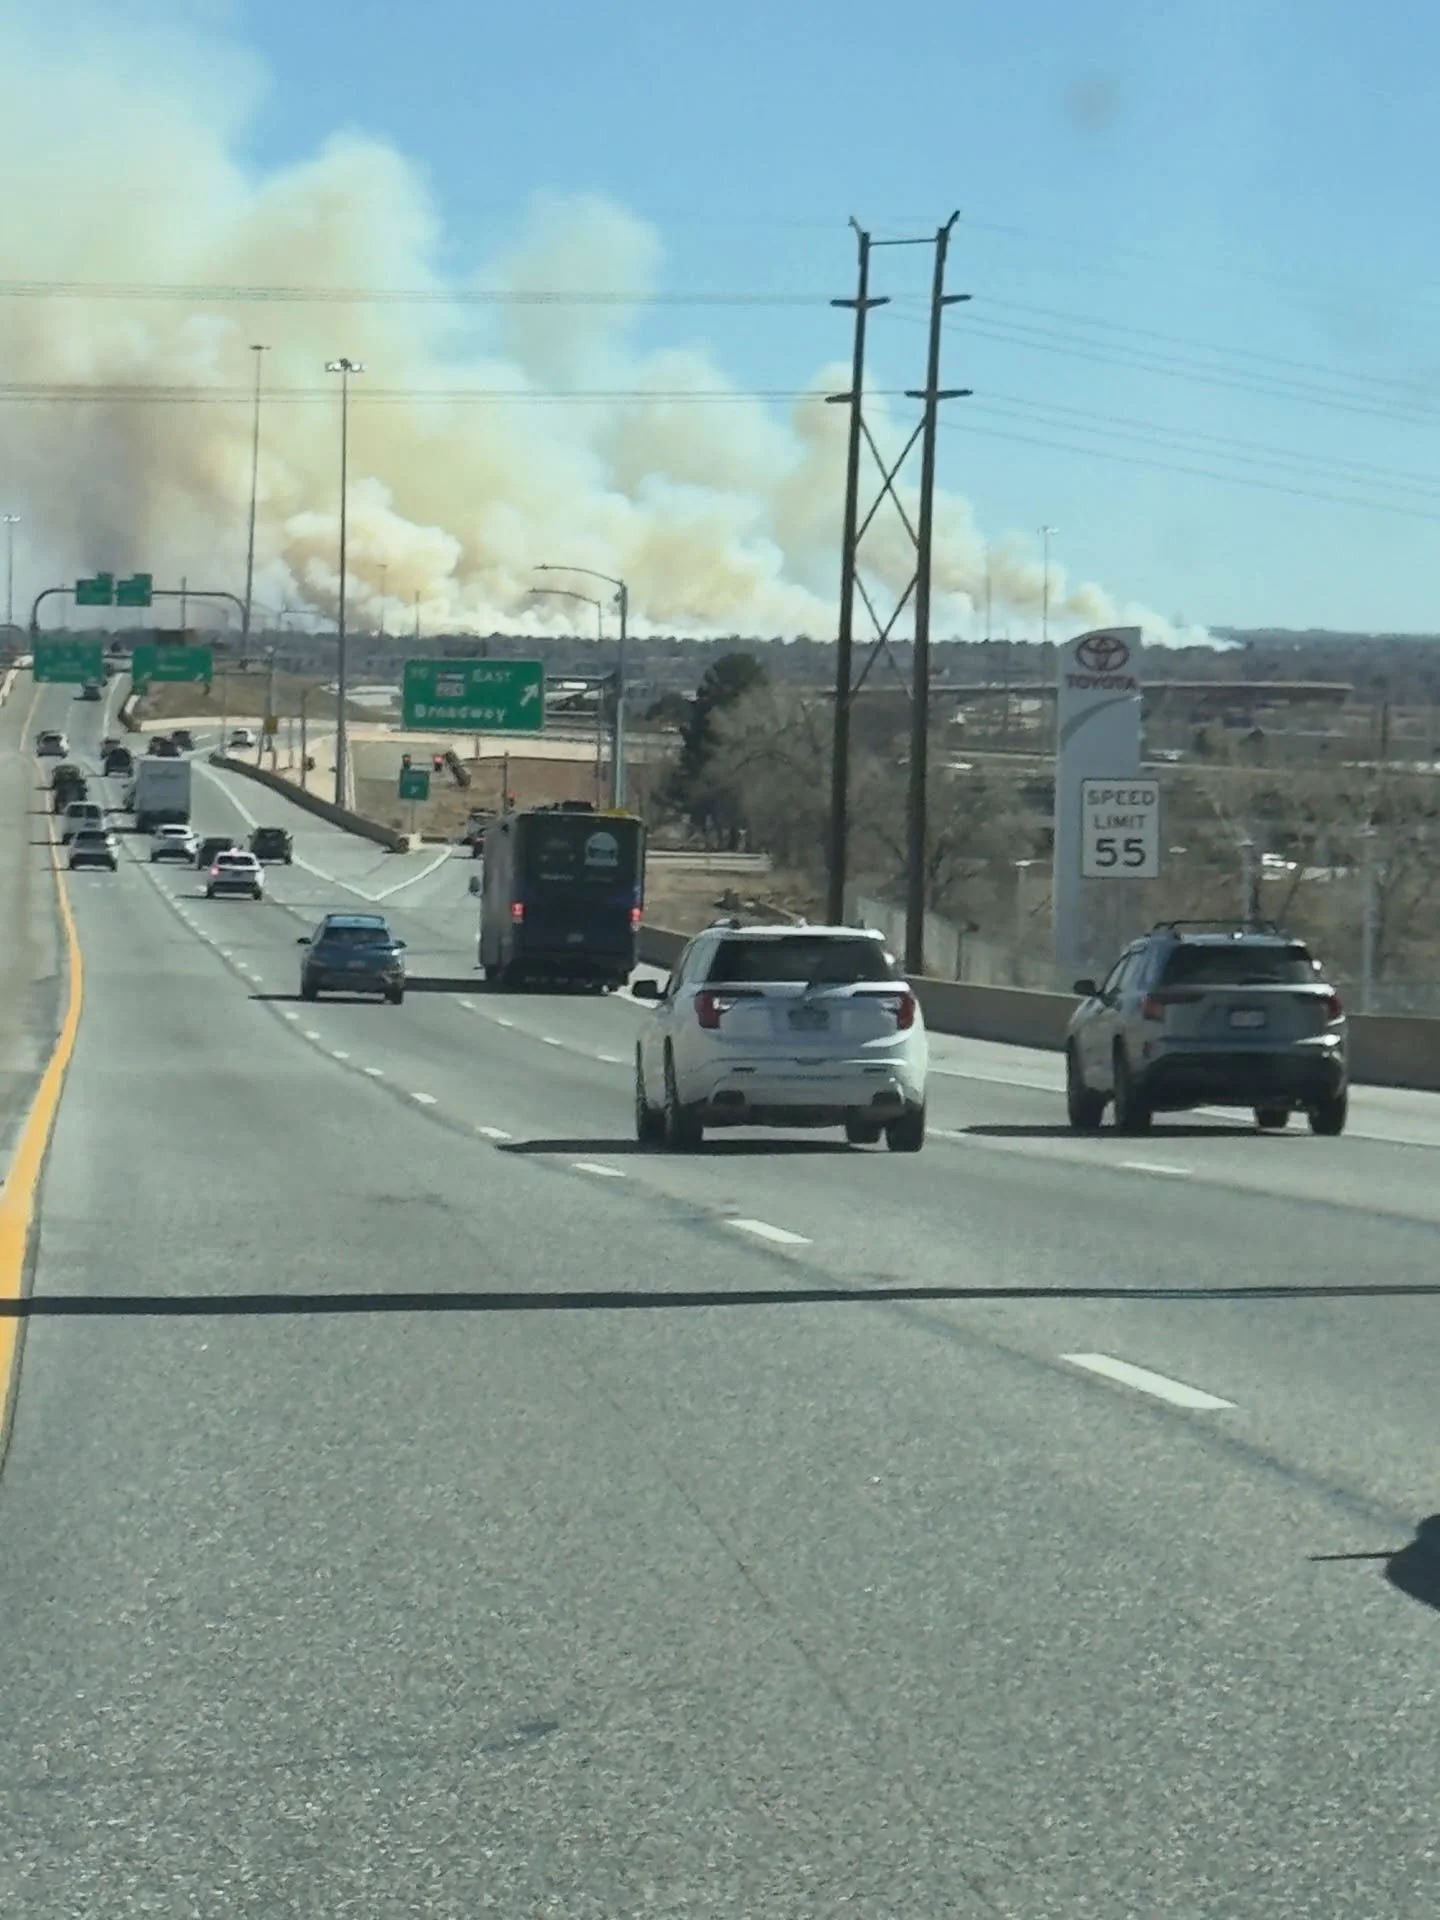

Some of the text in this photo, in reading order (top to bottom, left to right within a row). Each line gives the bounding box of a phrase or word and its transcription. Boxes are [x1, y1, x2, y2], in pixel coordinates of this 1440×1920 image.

[1066, 674, 1137, 690] TOYOTA
[414, 704, 507, 723] Broadway
[1087, 790, 1155, 806] SPEED
[1093, 815, 1146, 830] LIMIT
[1095, 838, 1147, 867] 55
